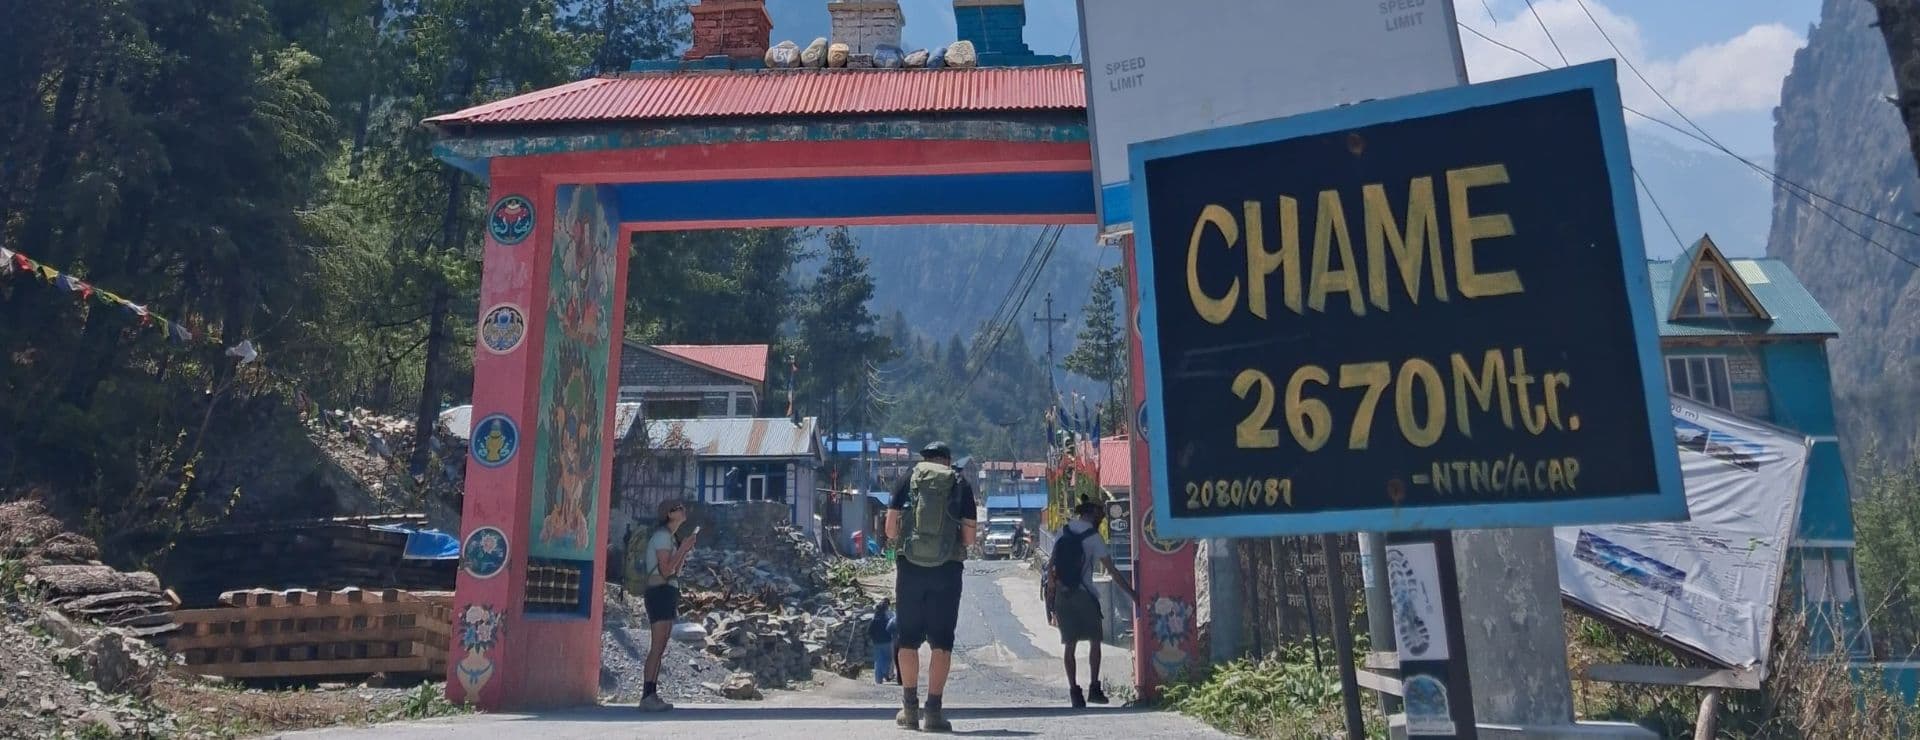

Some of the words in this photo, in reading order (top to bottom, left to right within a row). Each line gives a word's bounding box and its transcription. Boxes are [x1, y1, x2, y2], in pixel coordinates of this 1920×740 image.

[1385, 12, 1424, 31] LIMIT
[1105, 57, 1146, 76] SPEED
[1110, 74, 1145, 91] LIMIT
[1187, 163, 1525, 325] CHAME
[1186, 477, 1293, 510] 2080/081
